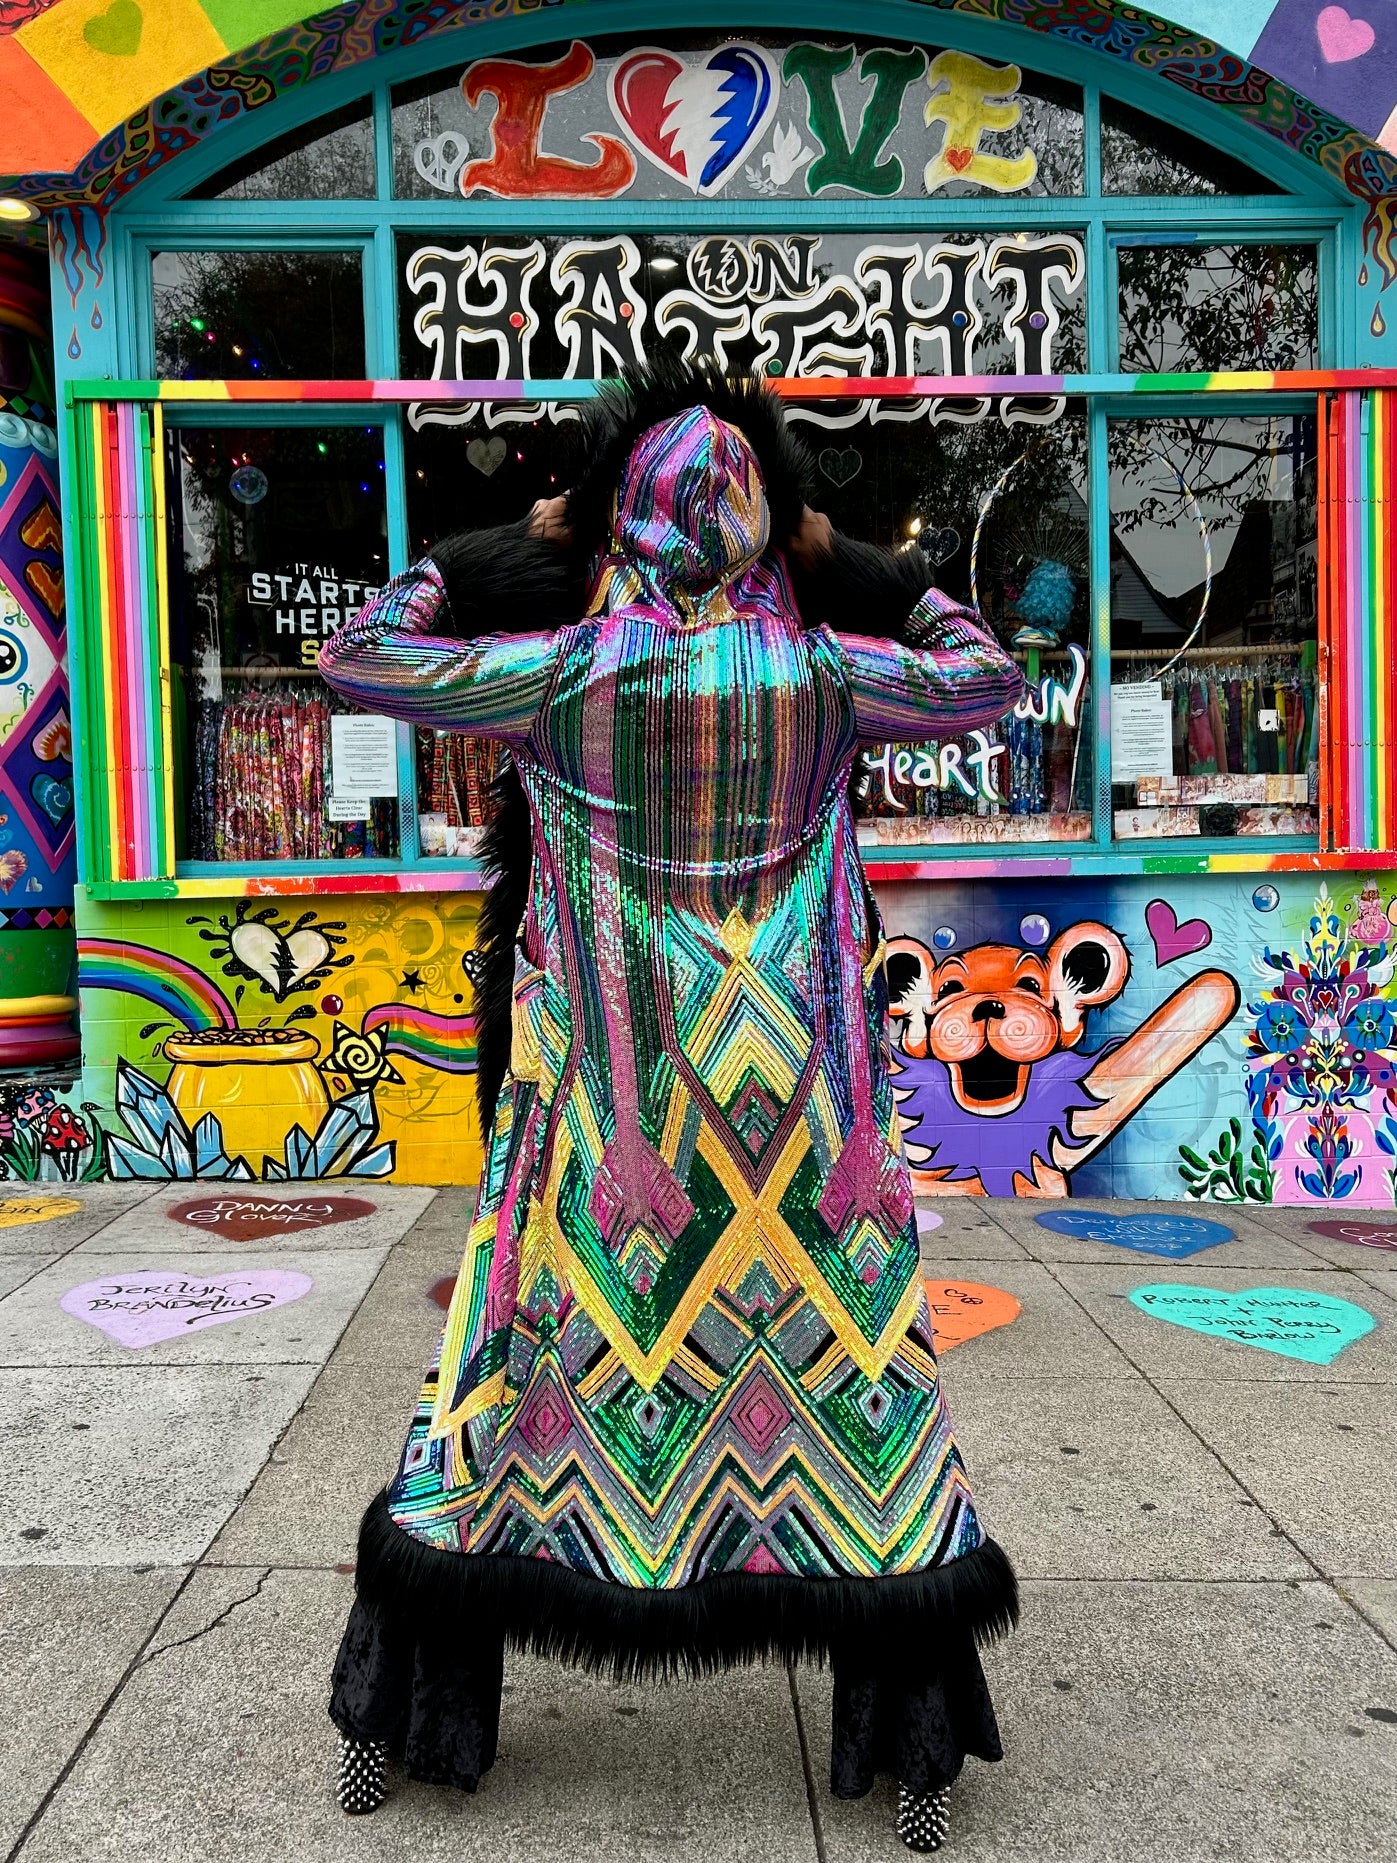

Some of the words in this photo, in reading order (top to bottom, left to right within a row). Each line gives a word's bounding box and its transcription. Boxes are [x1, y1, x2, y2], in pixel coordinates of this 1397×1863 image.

[687, 236, 821, 302] ON
[295, 563, 308, 575] IT
[313, 565, 338, 580] ALL
